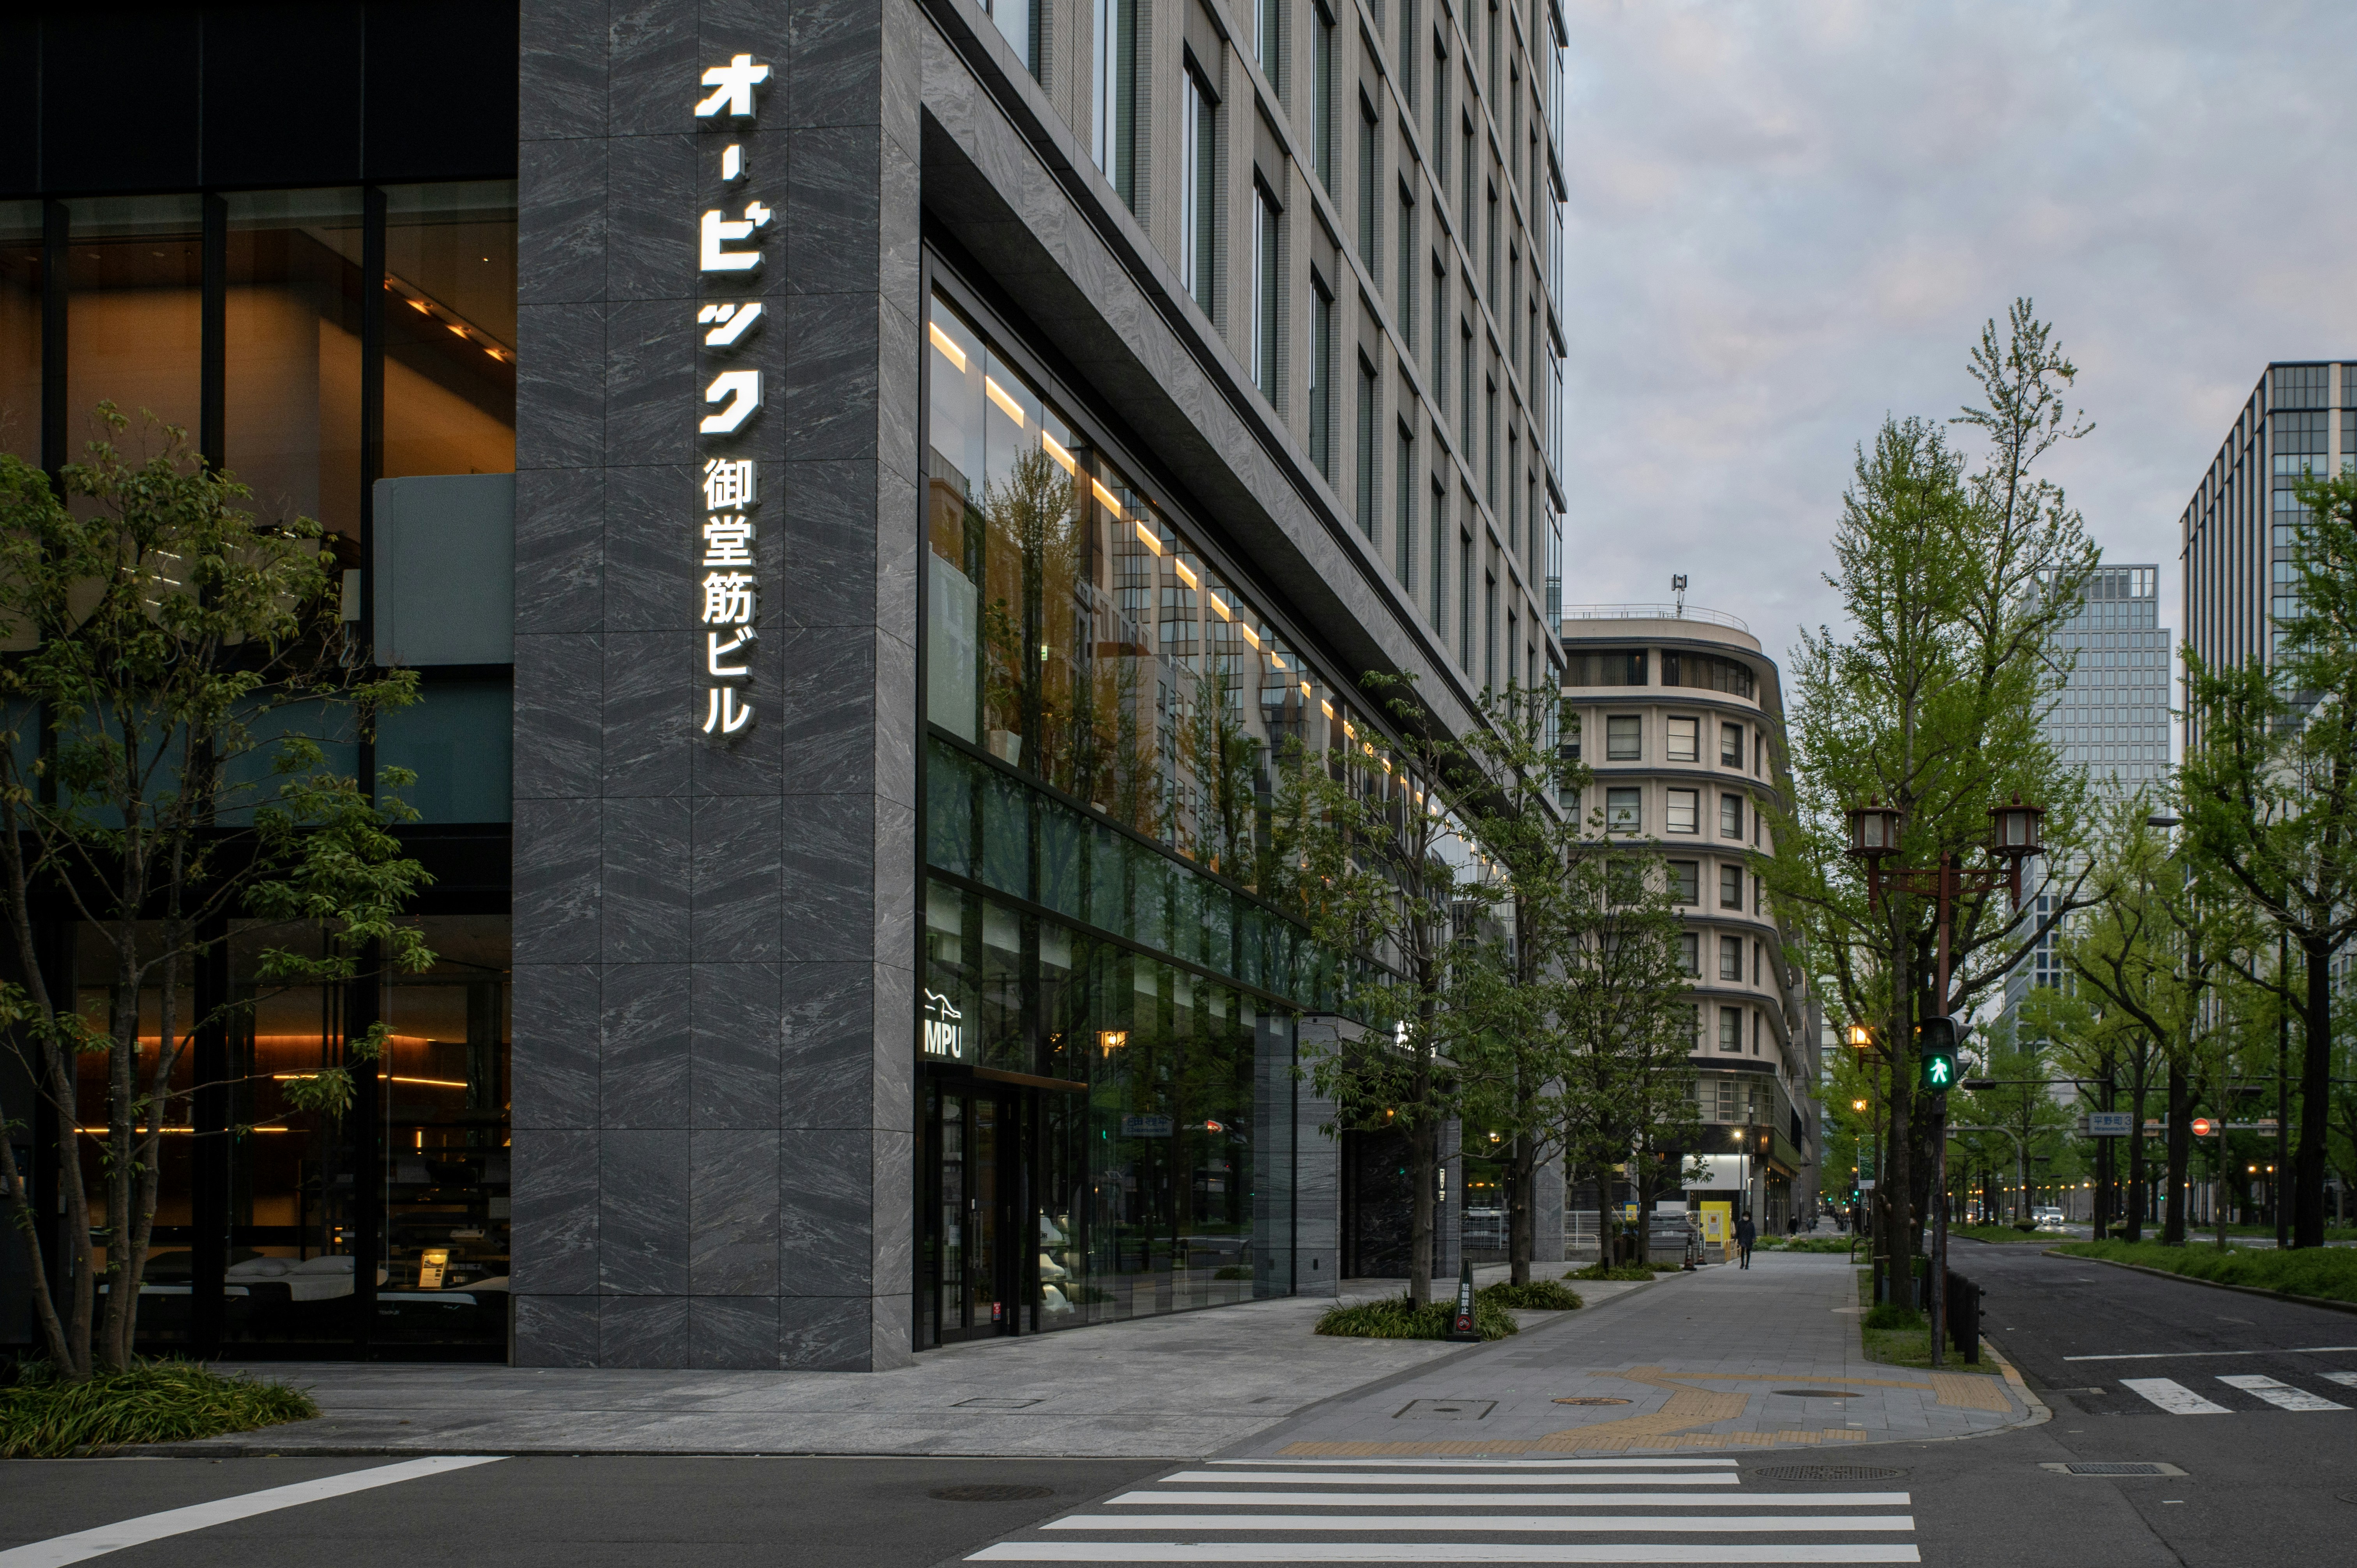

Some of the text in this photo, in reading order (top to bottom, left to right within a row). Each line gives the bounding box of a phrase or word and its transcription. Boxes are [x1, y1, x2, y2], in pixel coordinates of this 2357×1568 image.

[925, 1019, 961, 1058] MPU
[2094, 1116, 2132, 1125] 平野町3
[1461, 1283, 1470, 1314] 駐輪禁止
